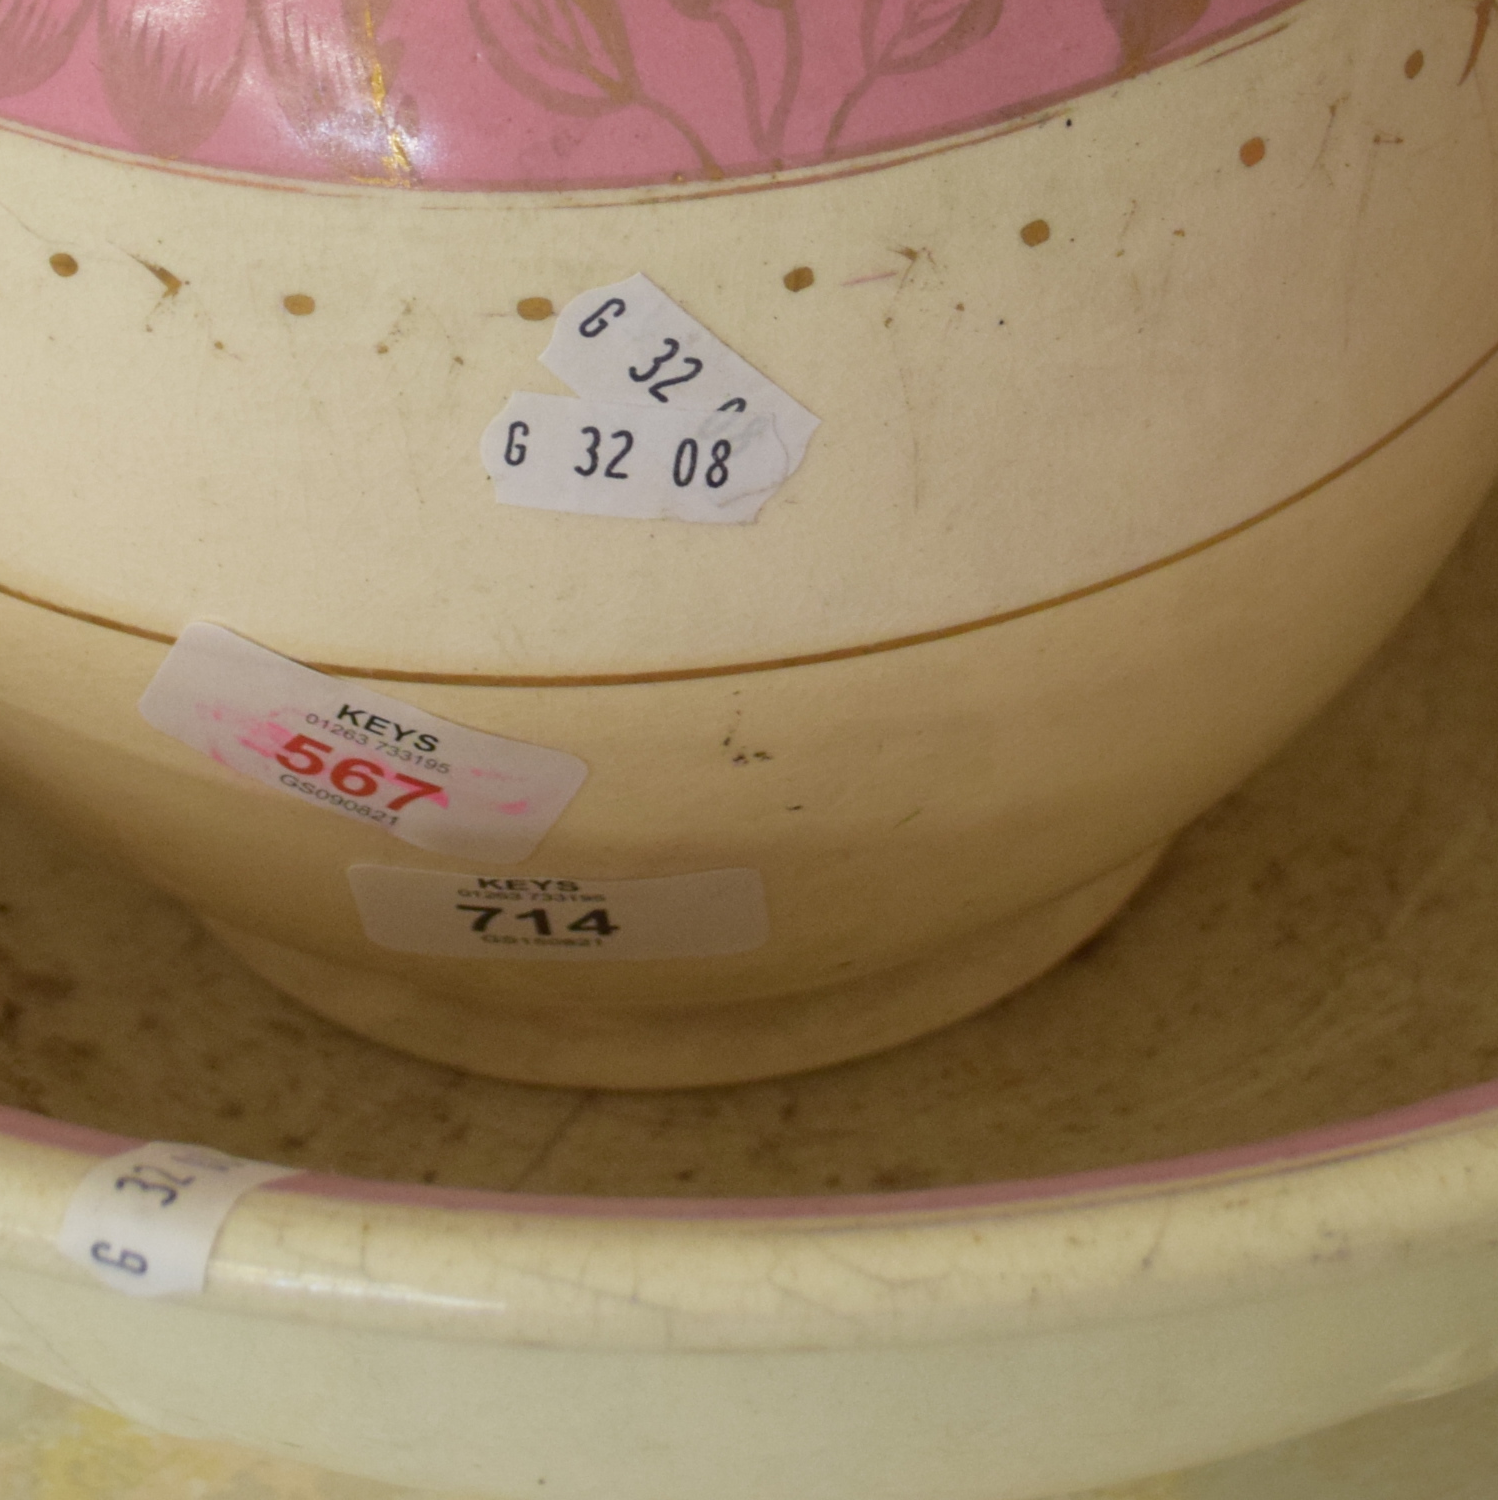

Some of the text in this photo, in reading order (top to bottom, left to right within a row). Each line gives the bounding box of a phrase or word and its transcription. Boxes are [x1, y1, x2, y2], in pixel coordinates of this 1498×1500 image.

[578, 298, 703, 403] G 32
[504, 421, 732, 488] G 32 08
[305, 713, 451, 775] 01263 733195
[337, 704, 440, 752] KEYS
[274, 733, 444, 811] 567
[477, 878, 581, 892] KEYS
[455, 904, 621, 936] 714
[90, 1240, 148, 1276] G
